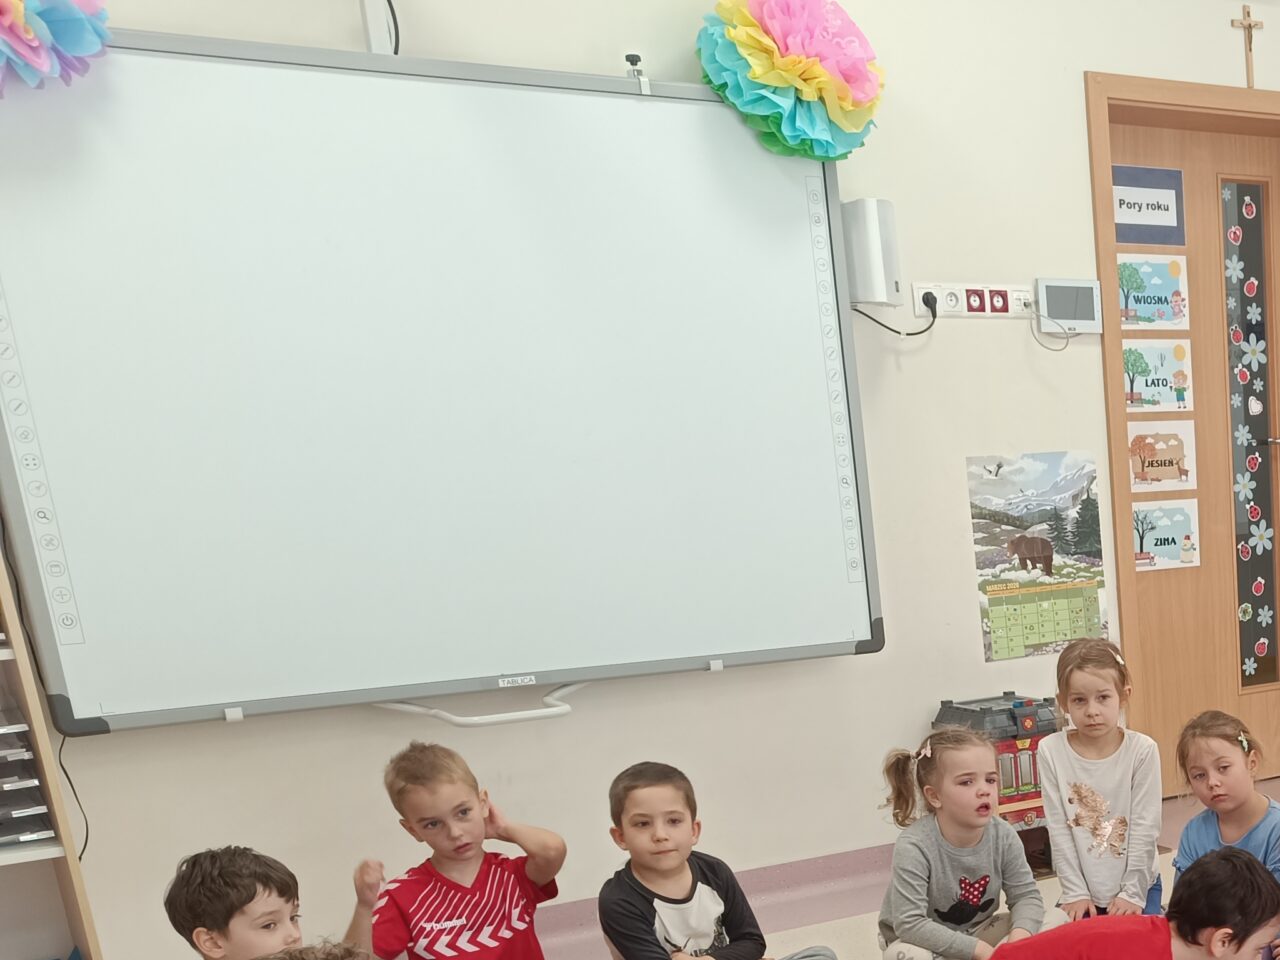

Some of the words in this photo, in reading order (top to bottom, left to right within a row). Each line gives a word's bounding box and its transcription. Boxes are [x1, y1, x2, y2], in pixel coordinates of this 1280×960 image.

[1118, 198, 1142, 213] Pory
[1146, 201, 1170, 212] roku
[1133, 294, 1170, 306] WIOSNA
[1145, 378, 1168, 388] LATO
[1145, 457, 1174, 468] JESIEŃ
[1153, 536, 1177, 547] ZIMA
[432, 917, 467, 930] hummel
